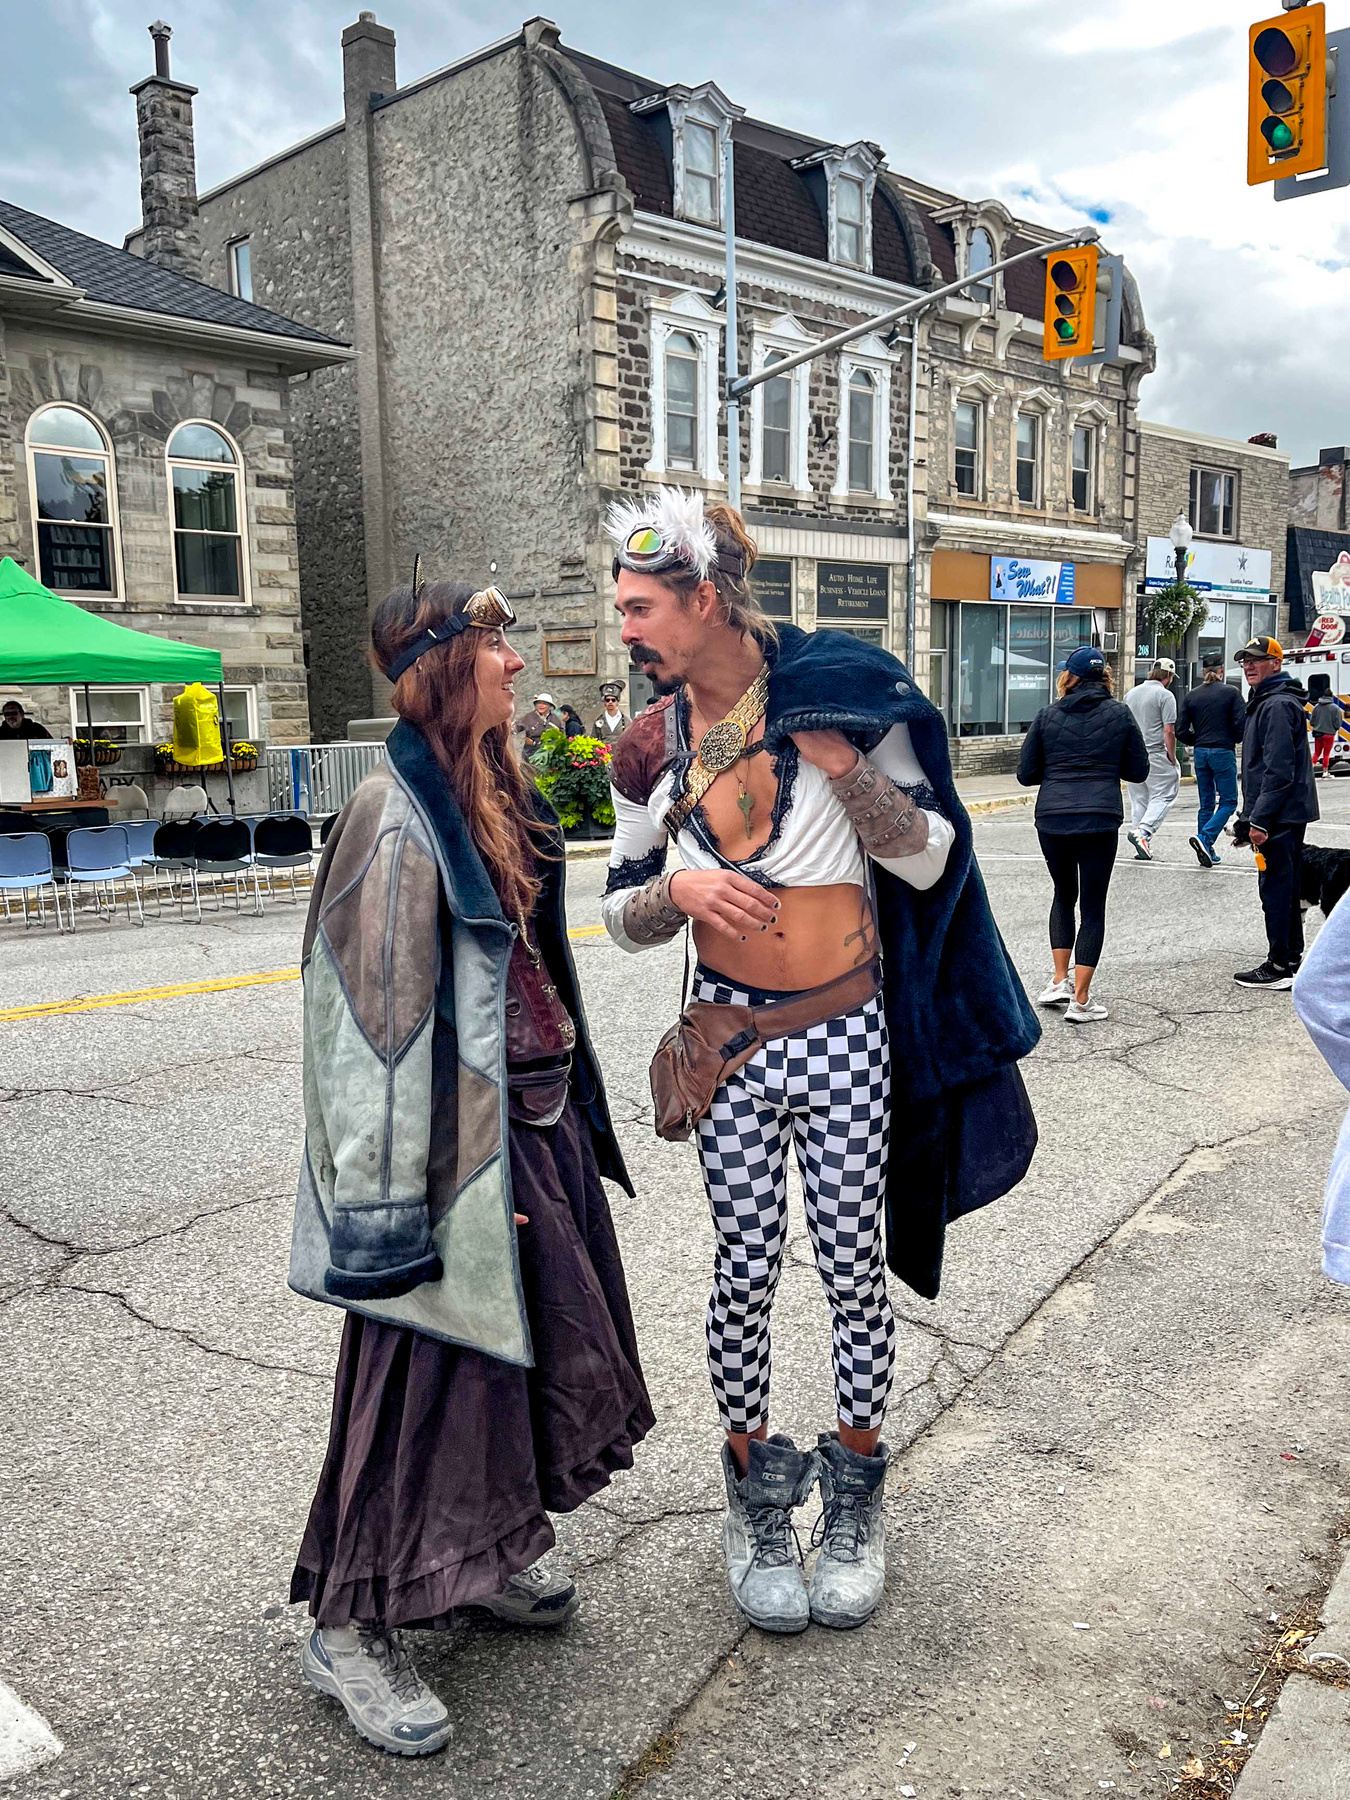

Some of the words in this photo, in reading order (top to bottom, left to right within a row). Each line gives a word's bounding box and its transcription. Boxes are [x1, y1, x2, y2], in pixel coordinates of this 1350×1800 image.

[1008, 560, 1031, 580] Sew
[829, 573, 844, 582] AUTO
[847, 574, 864, 584] HOME
[866, 575, 878, 584] LIFE
[820, 585, 844, 595] BUSINESS
[847, 586, 869, 596] VEHICLE
[869, 587, 887, 597] LOANS
[1016, 575, 1057, 598] What?!
[837, 598, 870, 608] RETIREMENT
[1138, 644, 1150, 655] 208
